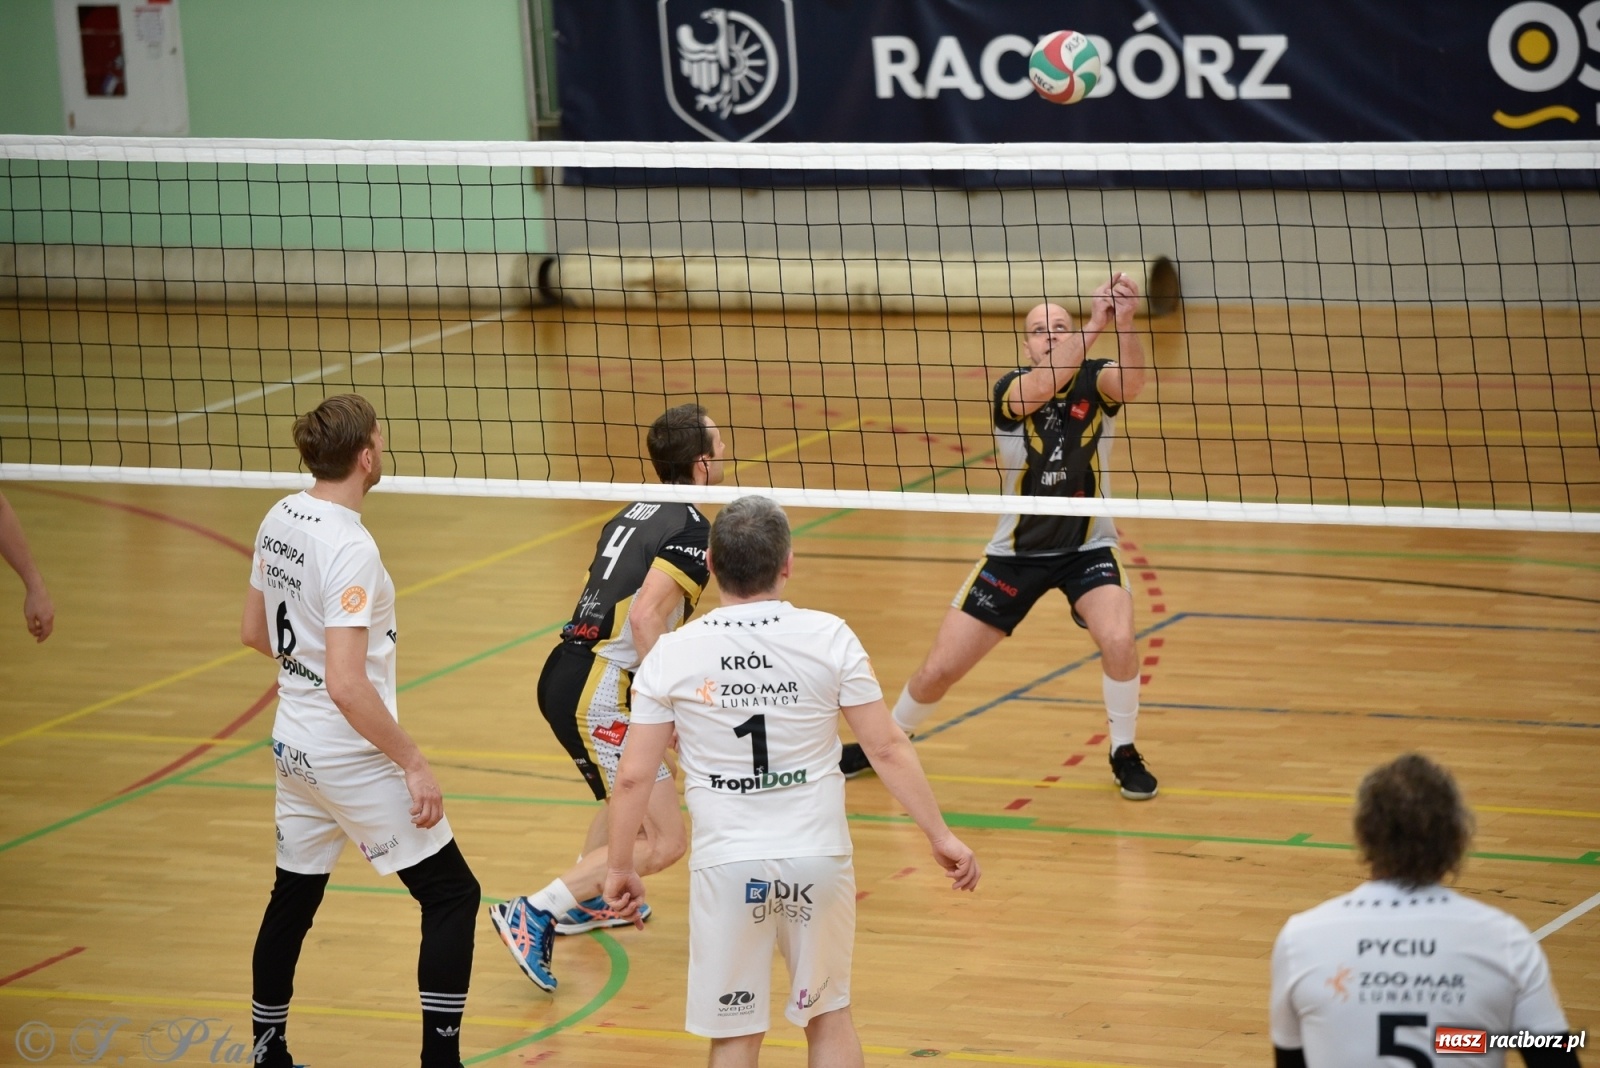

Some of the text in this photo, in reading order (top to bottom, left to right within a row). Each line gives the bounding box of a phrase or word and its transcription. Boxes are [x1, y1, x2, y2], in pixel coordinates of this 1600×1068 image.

[872, 12, 1291, 99] RACBÓRZ
[262, 535, 305, 567] SKORUPA
[601, 525, 637, 580] 4
[276, 600, 297, 656] 6
[720, 651, 773, 671] KRÓL
[721, 694, 799, 709] LUNATYCY
[733, 713, 769, 775] 1
[752, 898, 812, 924] glass
[1357, 938, 1437, 957] PYCIU
[1377, 1012, 1434, 1068] 5
